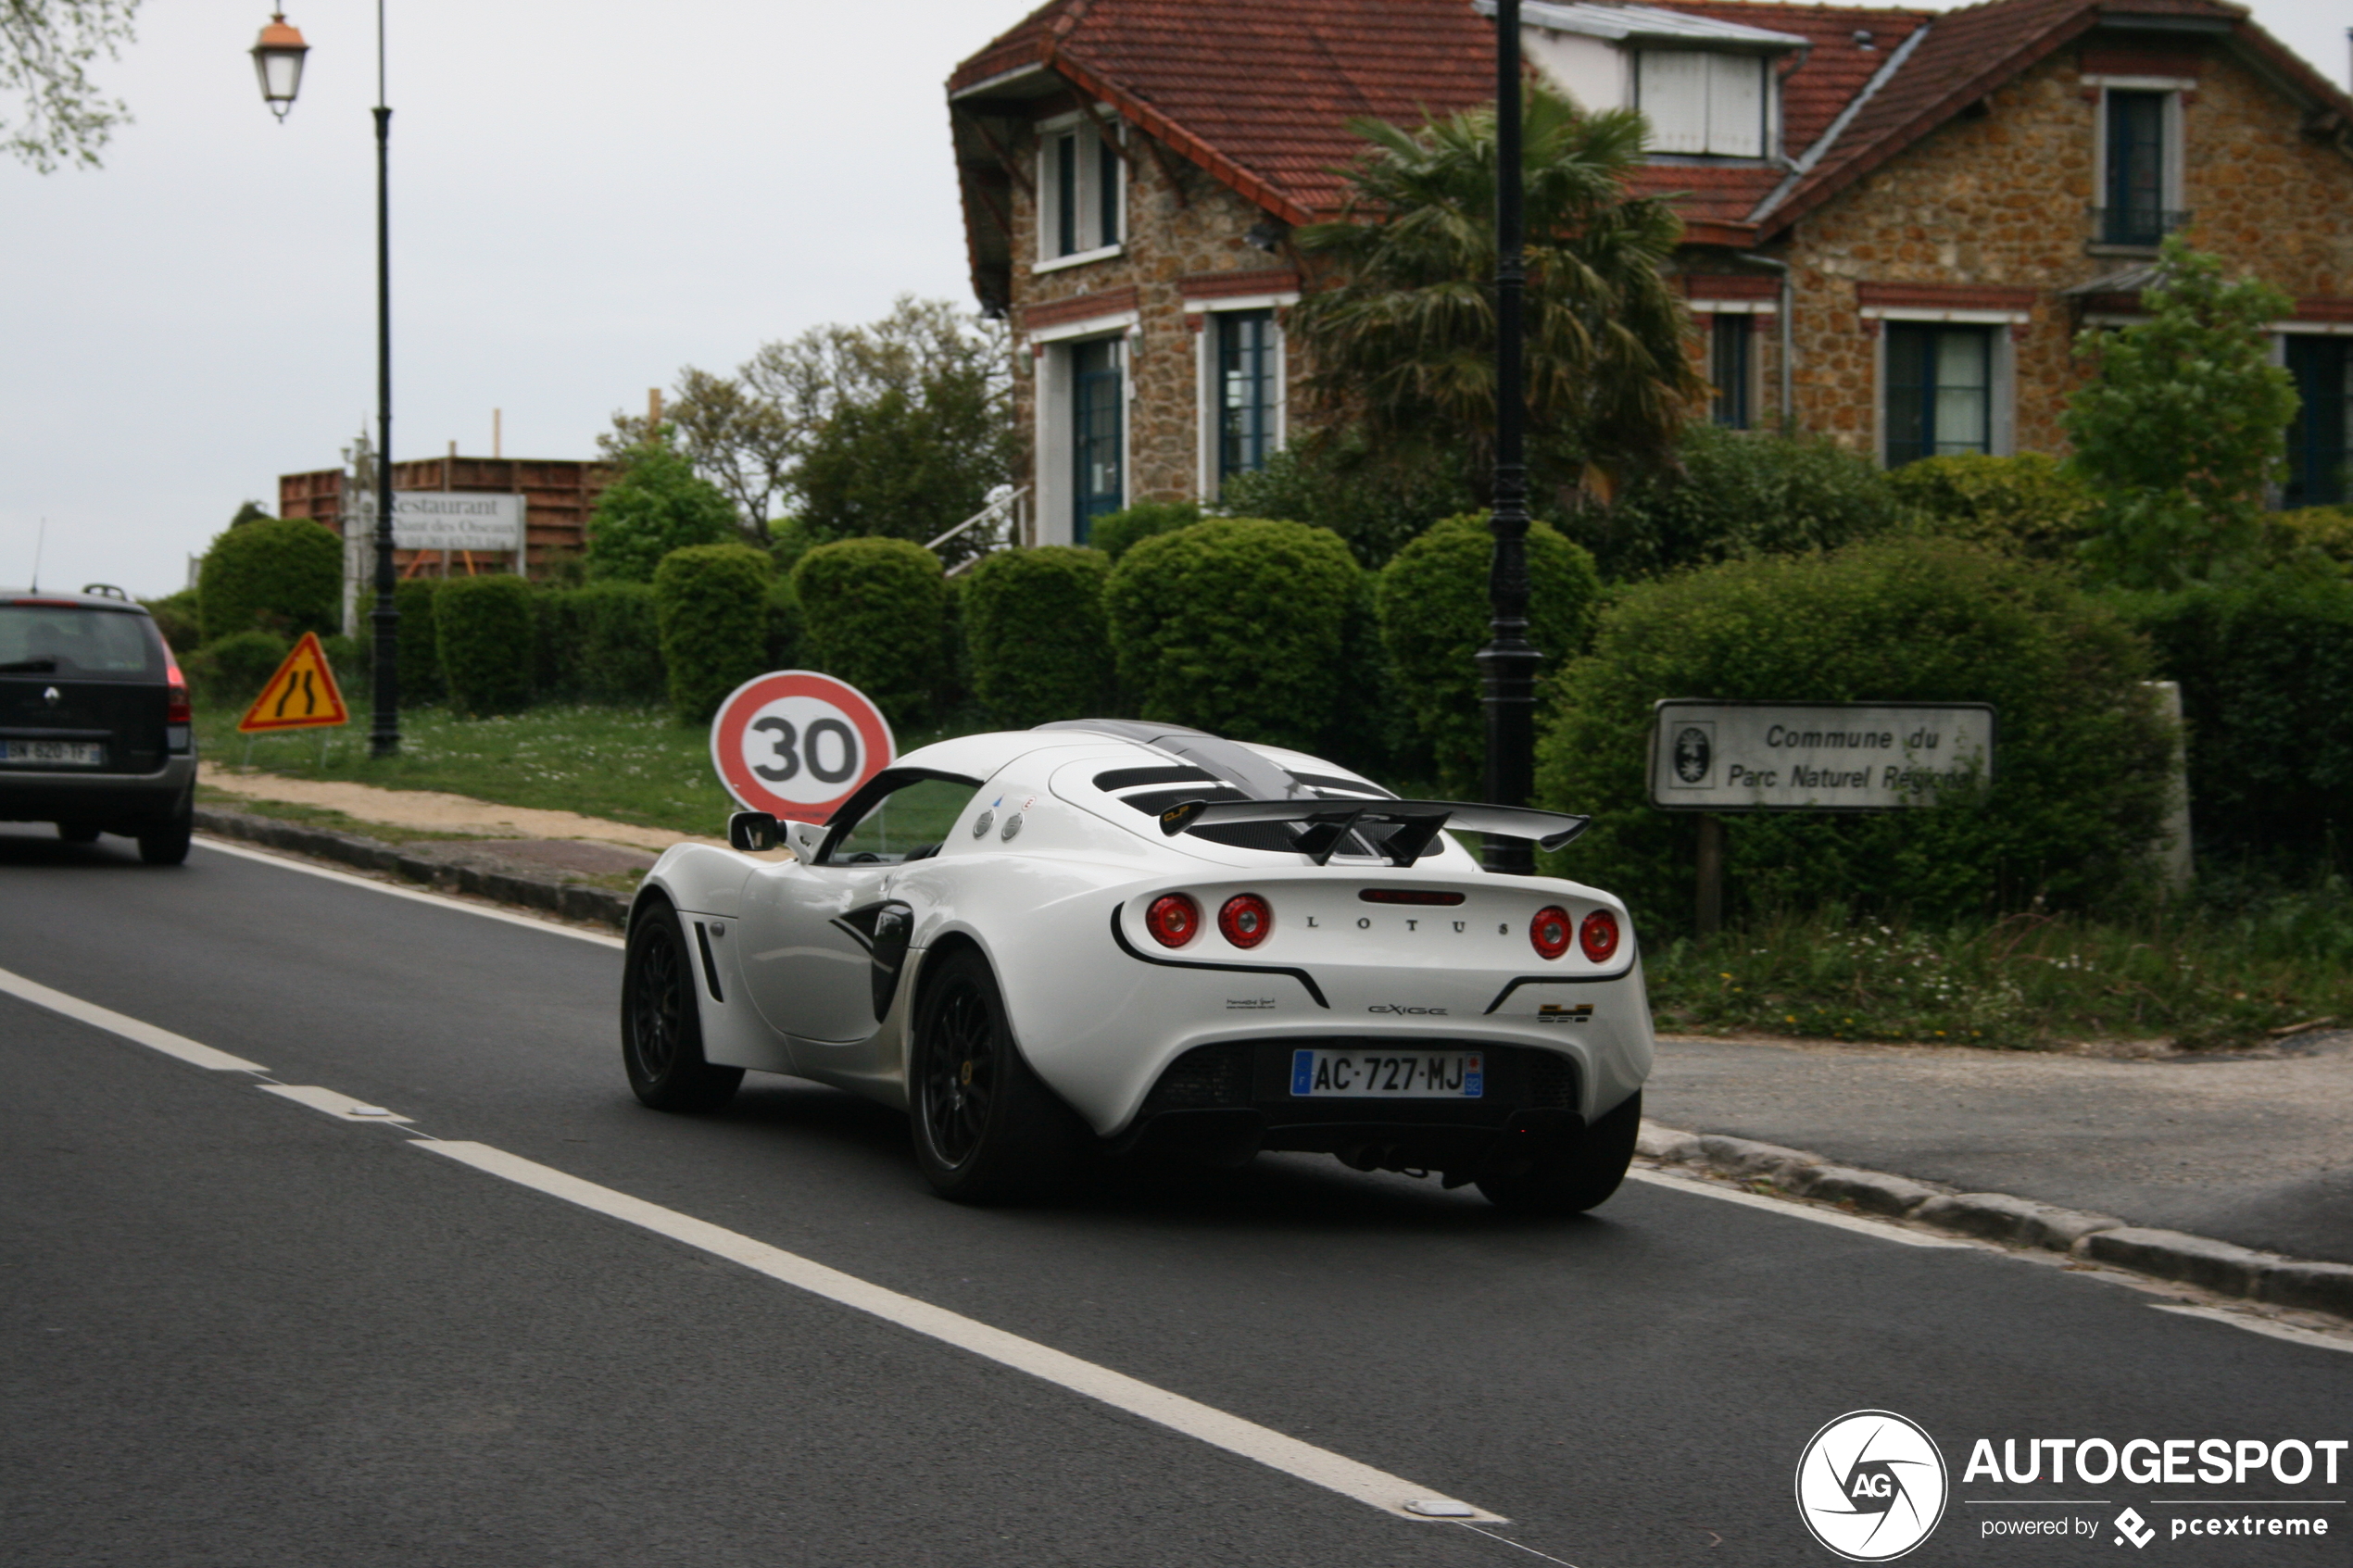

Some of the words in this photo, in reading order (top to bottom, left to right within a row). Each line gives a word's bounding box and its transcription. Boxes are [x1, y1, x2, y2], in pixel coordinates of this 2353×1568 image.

[393, 497, 497, 515] estaurant
[1767, 724, 1893, 748] Commune
[1909, 726, 1939, 748] du
[752, 716, 858, 784] 30
[1727, 763, 1778, 787] Parc
[1790, 764, 1871, 787] Naturel
[1307, 916, 1508, 935] LOTUS
[1314, 1058, 1463, 1090] AC-727-MJ
